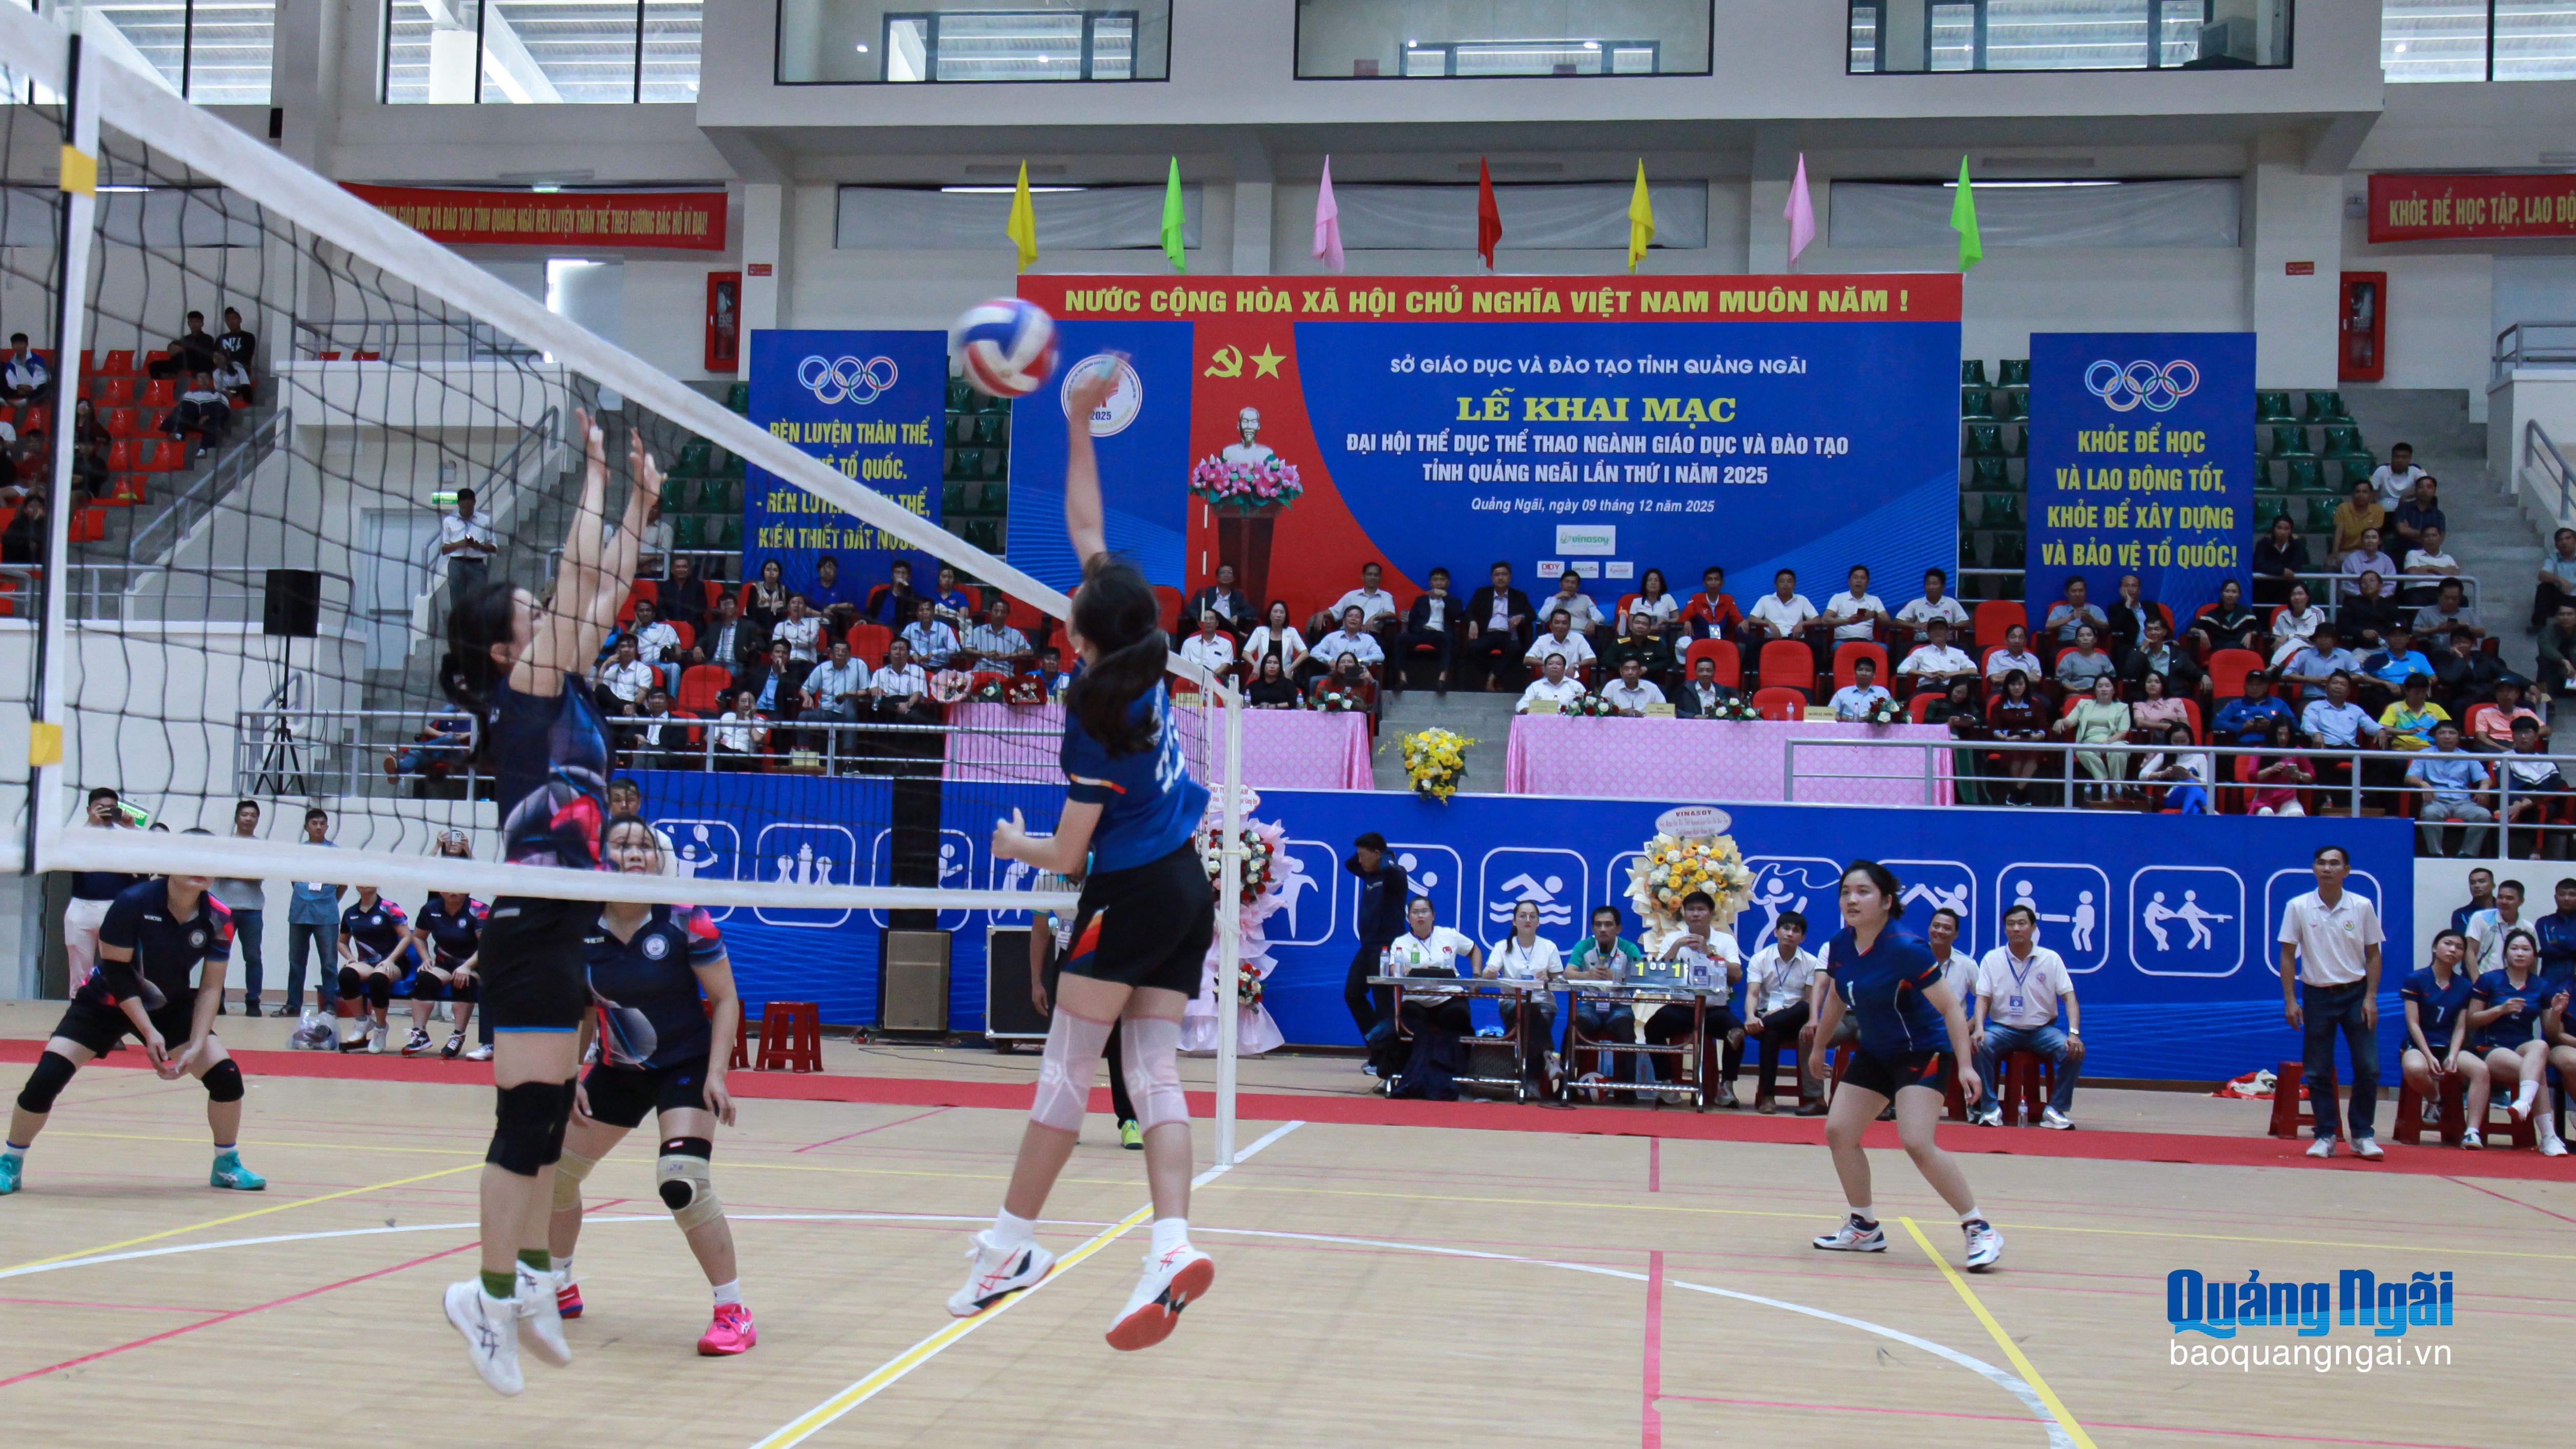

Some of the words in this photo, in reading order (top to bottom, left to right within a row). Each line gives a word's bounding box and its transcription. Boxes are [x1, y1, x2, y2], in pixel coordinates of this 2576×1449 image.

[459, 207, 472, 236] TẠO
[611, 210, 629, 234] THEO
[656, 205, 671, 235] BÁC
[2389, 190, 2427, 226] KHỎE
[2432, 188, 2453, 225] ĐỂ
[2456, 198, 2486, 231] HỌC
[2490, 191, 2520, 230] TẬP,
[2525, 196, 2552, 223] LAO
[1065, 286, 1141, 312] NƯỚC
[1150, 286, 1227, 316] CỘNG
[1236, 286, 1293, 313] HÒA
[1302, 287, 1339, 313] XÃ
[1349, 287, 1395, 317] HỘI
[1406, 285, 1462, 314] CHỦ
[1472, 287, 1561, 314] NGHĨA
[1570, 287, 1632, 318] VIỆT
[1641, 291, 1708, 313] NAM
[1719, 286, 1808, 313] MUÔN
[1818, 286, 1888, 312] NĂM
[1391, 354, 1415, 374] SỞ
[1420, 355, 1468, 374] GIÁO
[1473, 359, 1512, 377] DỤC
[1518, 355, 1543, 374] VÀ
[1549, 356, 1590, 374] ĐÀO
[1596, 360, 1632, 377] TẠO
[1638, 355, 1678, 374] TỈNH
[1684, 355, 1753, 374] QUẢNG
[1760, 356, 1806, 374] NGÃI
[1456, 387, 1515, 421] LỄ
[1522, 397, 1630, 421] KHAI
[1642, 398, 1736, 429] MẠC
[770, 418, 799, 443] RÈN
[804, 419, 852, 448] LUYỆN
[857, 419, 896, 444] THÂN
[901, 416, 933, 447] THỂ,
[1347, 433, 1376, 454] ĐẠI
[1382, 430, 1411, 455] HỘI
[1416, 428, 1450, 452] THỂ
[1454, 434, 1489, 456] DỤC
[1495, 428, 1529, 453] THỂ
[1533, 435, 1578, 453] THAO
[1583, 432, 1646, 453] NGÀNH
[1652, 432, 1695, 454] GIÁO
[1700, 436, 1737, 458] DỤC
[1742, 433, 1766, 454] VÀ
[1771, 433, 1808, 454] ĐÀO
[1813, 437, 1848, 459] TẠO
[2078, 423, 2129, 452] KHỎE
[2135, 422, 2162, 452] ĐỂ
[2166, 430, 2206, 458] HỌC
[839, 450, 858, 479] TỔ
[862, 451, 908, 481] QUỐC.
[1423, 458, 1462, 482] TỈNH
[1468, 459, 1529, 483] QUẢNG
[1535, 461, 1578, 482] NGÃI
[1583, 460, 1618, 483] LẦN
[1624, 462, 1660, 483] THỨ
[1664, 465, 1670, 483] I
[1675, 462, 1718, 484] NĂM
[1723, 467, 1768, 484] 2025
[2056, 464, 2080, 490] VÀ
[2087, 468, 2122, 490] LAO
[2128, 464, 2182, 495] ĐỘNG
[2189, 461, 2226, 494] TỐT,
[1471, 496, 1510, 513] Quảng
[1514, 498, 1545, 513] Ngãi,
[1549, 500, 1579, 514] ngày
[1582, 500, 1596, 512] 09
[1600, 499, 1635, 514] tháng
[1639, 500, 1653, 512] 12
[1656, 500, 1682, 512] năm
[1685, 500, 1715, 512] 2025
[2048, 499, 2097, 528] KHỎE
[2104, 498, 2131, 528] ĐỂ
[2136, 502, 2173, 529] XÂY
[2179, 505, 2233, 533] DỰNG
[1572, 534, 1610, 546] vinasoy
[2042, 539, 2066, 566] VÀ
[2073, 536, 2112, 566] BẢO
[2118, 540, 2141, 571] VỆ
[2148, 536, 2172, 567] TỔ
[2177, 537, 2237, 570] QUỐC!
[1635, 962, 1644, 976] 1
[1672, 963, 1681, 977] 1
[1847, 981, 1856, 1005] 1
[2436, 1006, 2445, 1023] 7
